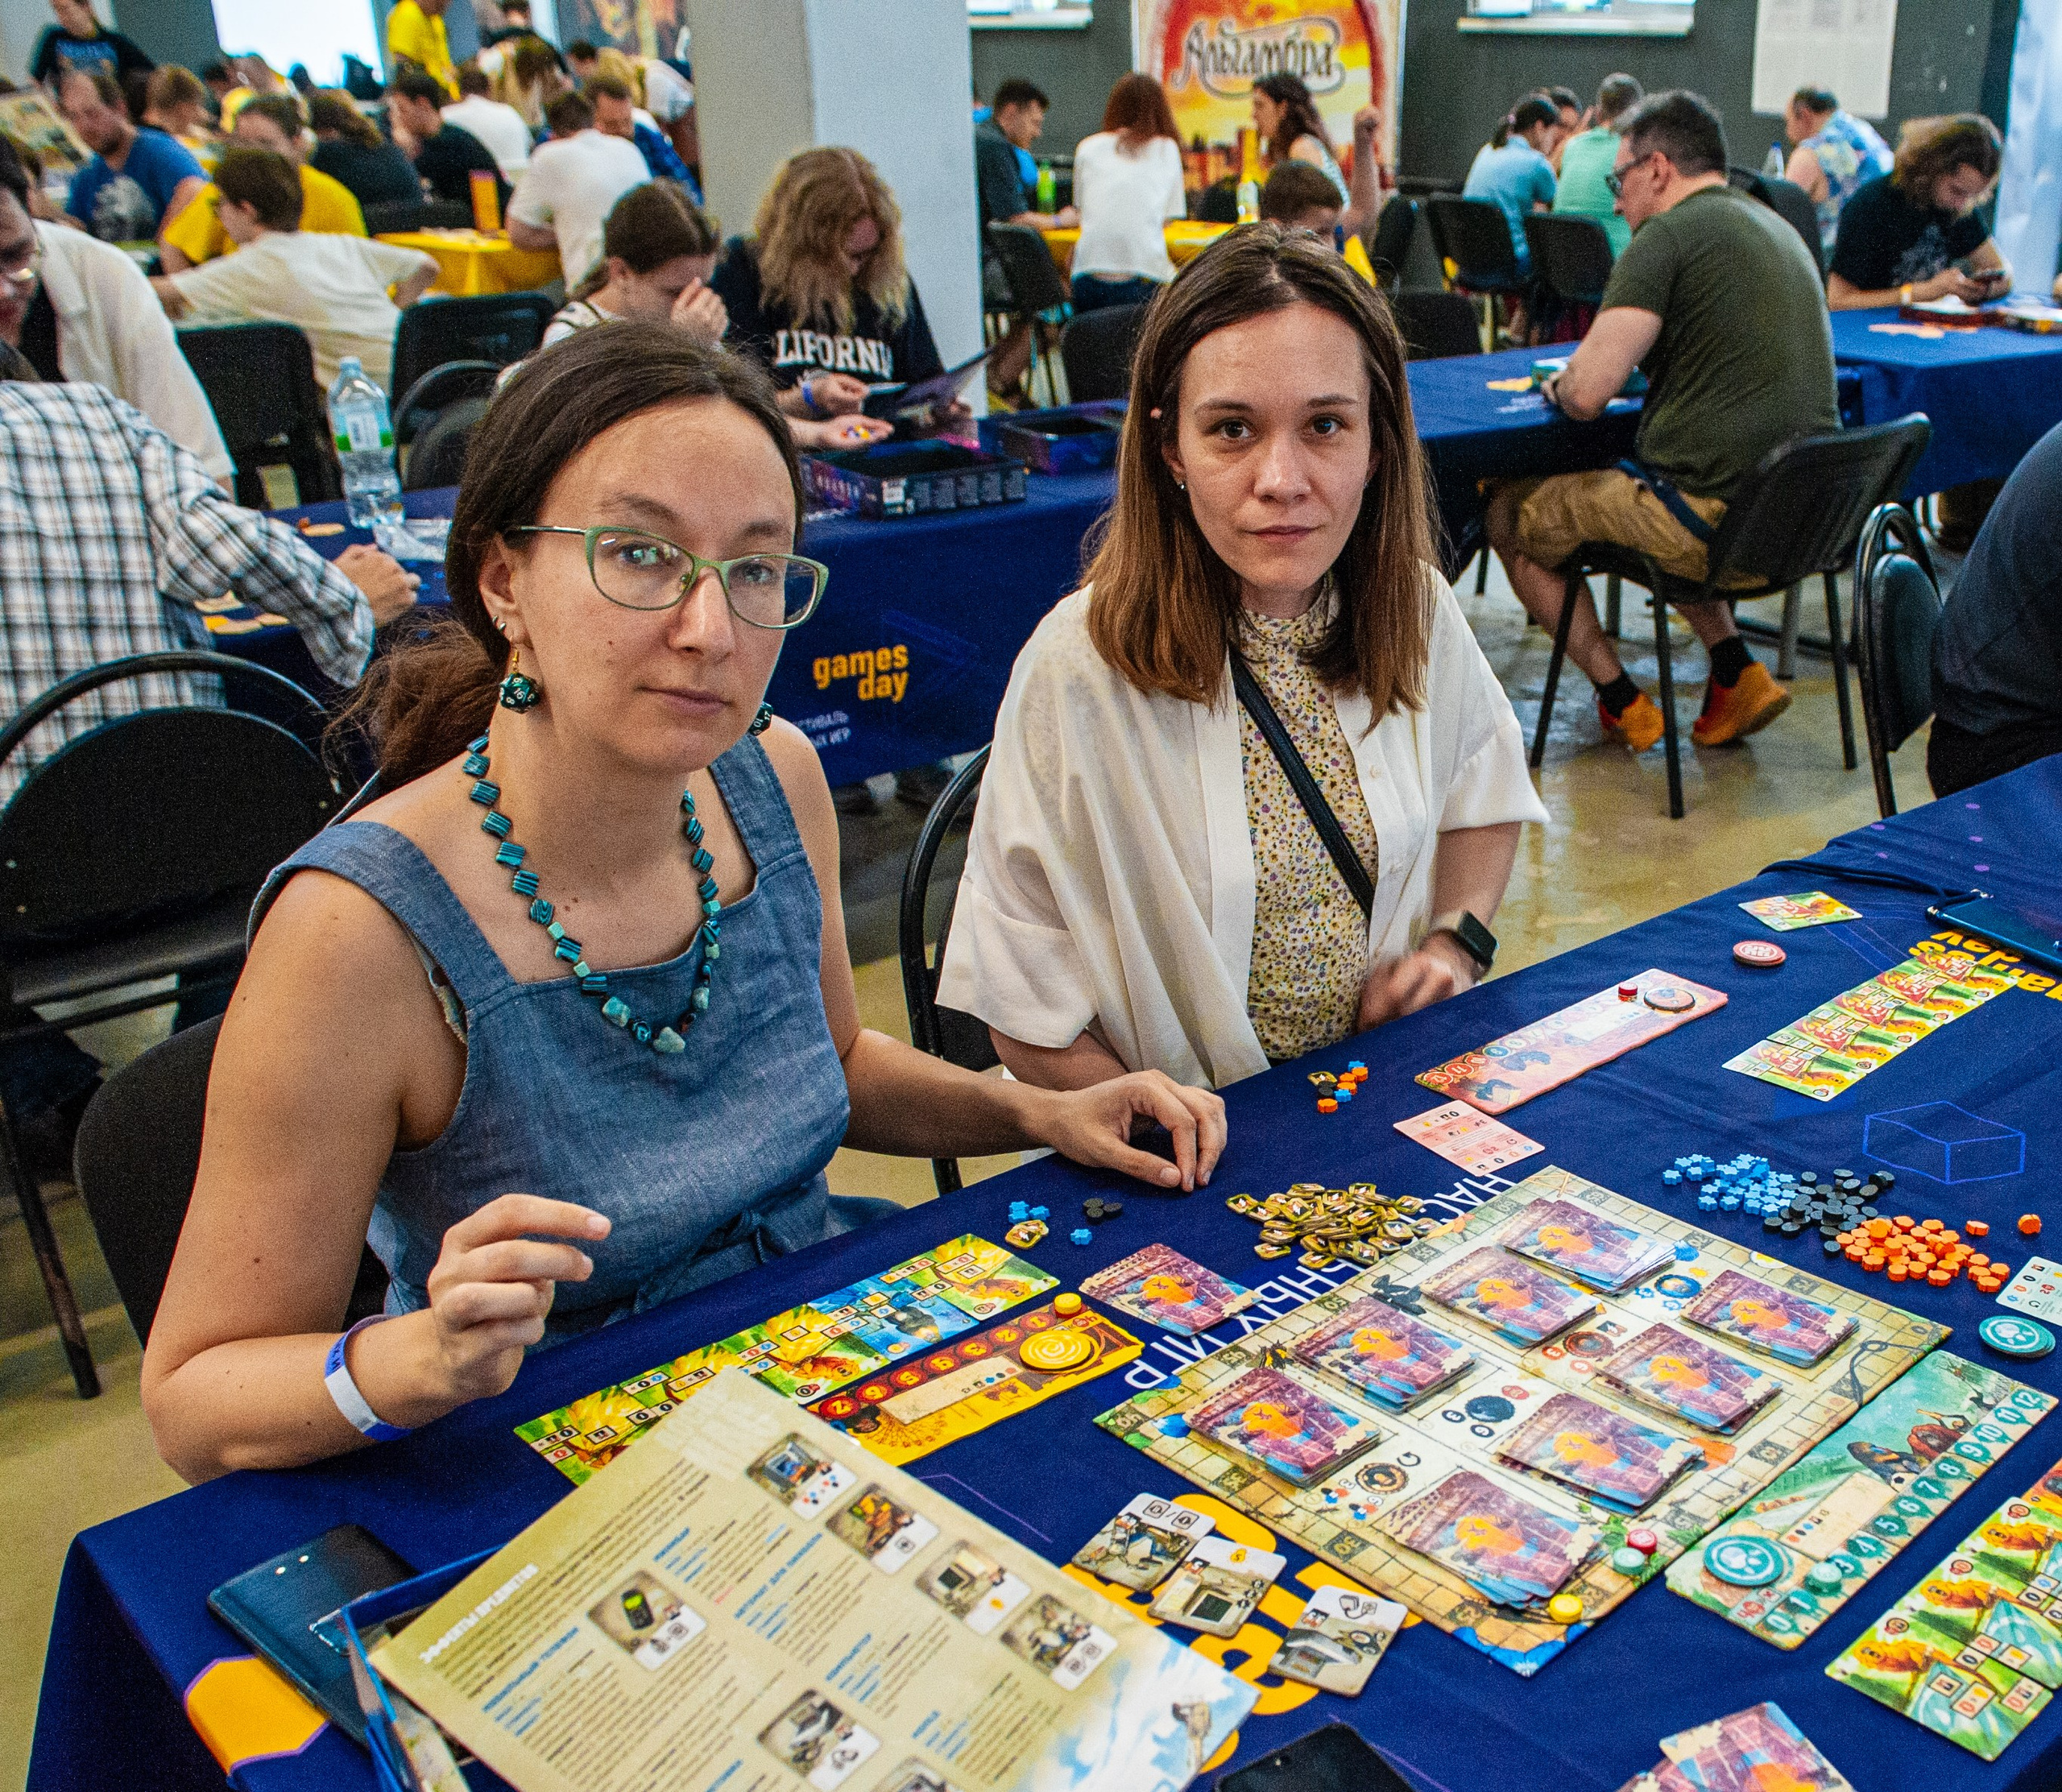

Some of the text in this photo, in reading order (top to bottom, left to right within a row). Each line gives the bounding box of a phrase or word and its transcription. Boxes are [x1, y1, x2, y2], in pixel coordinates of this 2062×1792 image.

[813, 644, 909, 689] games
[858, 669, 909, 704] day
[514, 688, 525, 700] 16
[997, 1329, 1016, 1342] 2
[965, 1343, 987, 1355] 3
[933, 1357, 955, 1370] 4
[900, 1371, 919, 1386] 5
[865, 1386, 884, 1399] 6
[1766, 1390, 2040, 1630] 12 11 10 9 8 7 6 5 4 3 1 0
[1333, 1537, 1361, 1557] 30
